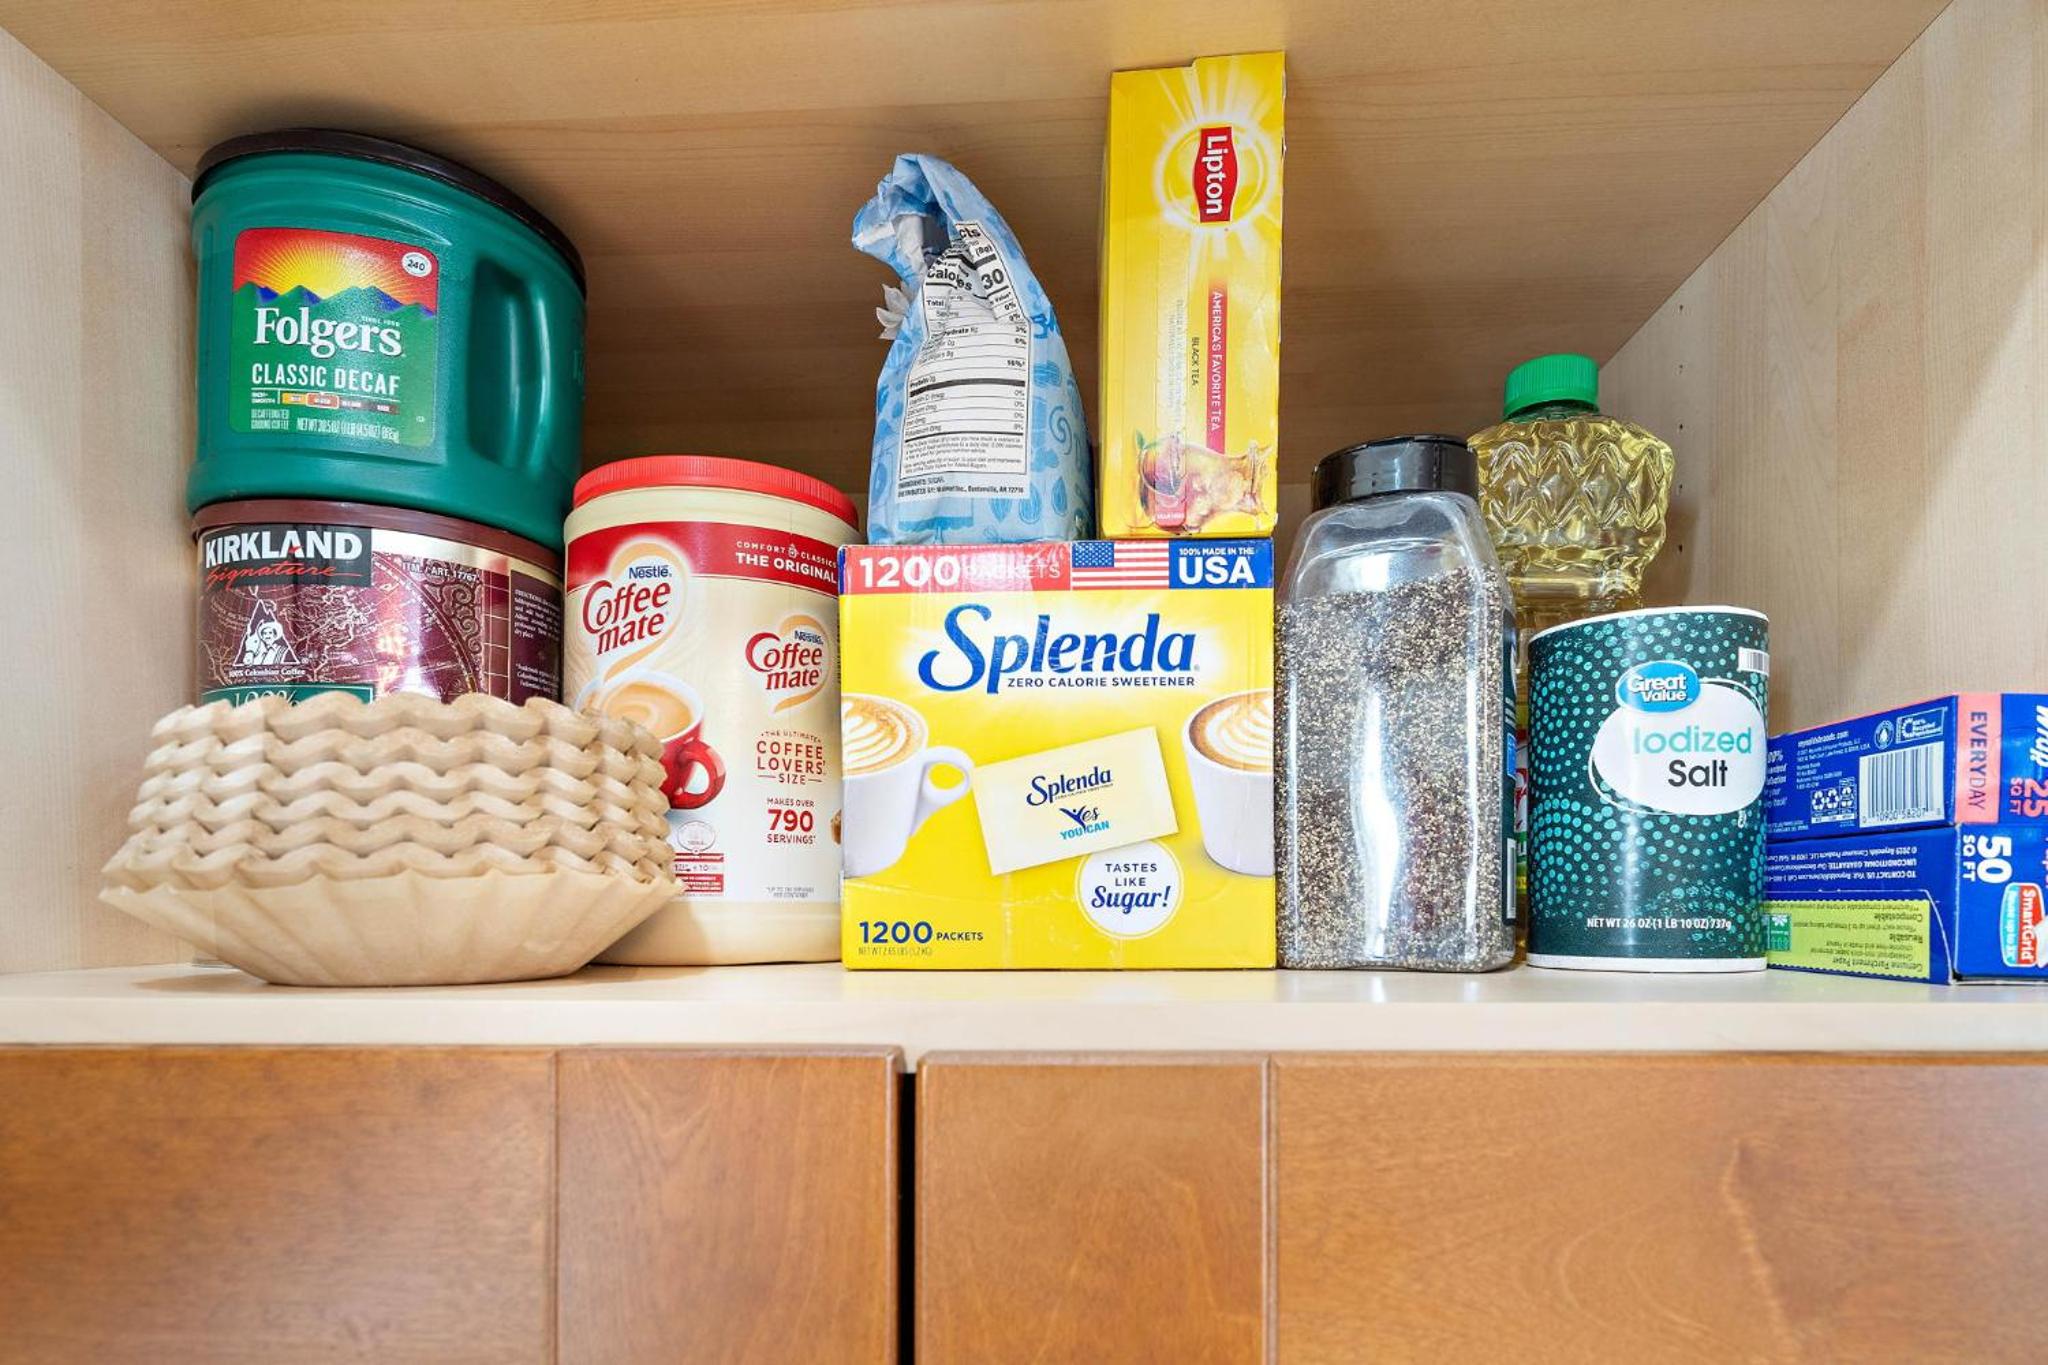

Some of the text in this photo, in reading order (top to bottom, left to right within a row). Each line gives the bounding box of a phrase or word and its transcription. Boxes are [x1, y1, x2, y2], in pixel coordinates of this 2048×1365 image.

[1201, 135, 1227, 215] Lipton
[407, 259, 426, 271] 240
[981, 268, 1005, 290] 30
[253, 306, 403, 358] Folgers
[1191, 337, 1200, 387] BLACK TEA
[1210, 291, 1223, 432] AMERICA'S FAVORITE TEA
[251, 362, 401, 396] CLASSIC DECAF
[205, 530, 363, 569] KIRKLAND
[736, 540, 838, 569] COMFORT CLASSICS
[1179, 547, 1256, 556] 100% MADE IN THE
[205, 561, 363, 592] Signature
[735, 552, 837, 584] THE ORIGINAL
[859, 555, 961, 588] 1200
[1178, 556, 1256, 585] USA
[582, 579, 672, 635] Coffee
[596, 612, 666, 656] mate
[918, 603, 1197, 694] Splenda
[745, 632, 823, 673] Coffee
[765, 668, 820, 690] mate
[1007, 675, 1196, 688] ZERO CALORIE SWEETENER
[1627, 672, 1688, 693] Great
[1642, 688, 1687, 703] Value
[756, 740, 824, 760] COFFEE
[1634, 725, 1752, 754] Iodized
[1667, 759, 1729, 787] Salt
[1967, 710, 1988, 811] EVERYDAY
[778, 773, 806, 785] SIZE
[1026, 766, 1112, 806] Splenda
[767, 797, 815, 808] MAKES OVER
[2008, 777, 2023, 816] SQ FT
[2022, 777, 2048, 818] 25
[767, 808, 814, 833] 790
[1059, 804, 1101, 832] Yes
[1060, 820, 1110, 840] YOU CAN
[1104, 863, 1158, 873] TASTES
[1962, 834, 1976, 882] SQ FT
[1976, 835, 2013, 884] 50
[1114, 877, 1147, 887] LIKE
[1091, 885, 1172, 915] Sugar!
[1587, 917, 1604, 928] NET
[1606, 917, 1621, 928] WT
[1622, 918, 1636, 929] 26
[1637, 917, 1650, 929] OZ
[1652, 917, 1663, 930] (1
[1664, 917, 1678, 929] LB
[1680, 917, 1692, 929] 10
[1710, 918, 1732, 931] 737g
[1874, 912, 1923, 923] Compostable
[2020, 888, 2037, 962] SmartGrid
[859, 921, 984, 944] 1200 PACKETS
[1889, 933, 1923, 944] Reusable
[1851, 957, 1890, 970] Parchment
